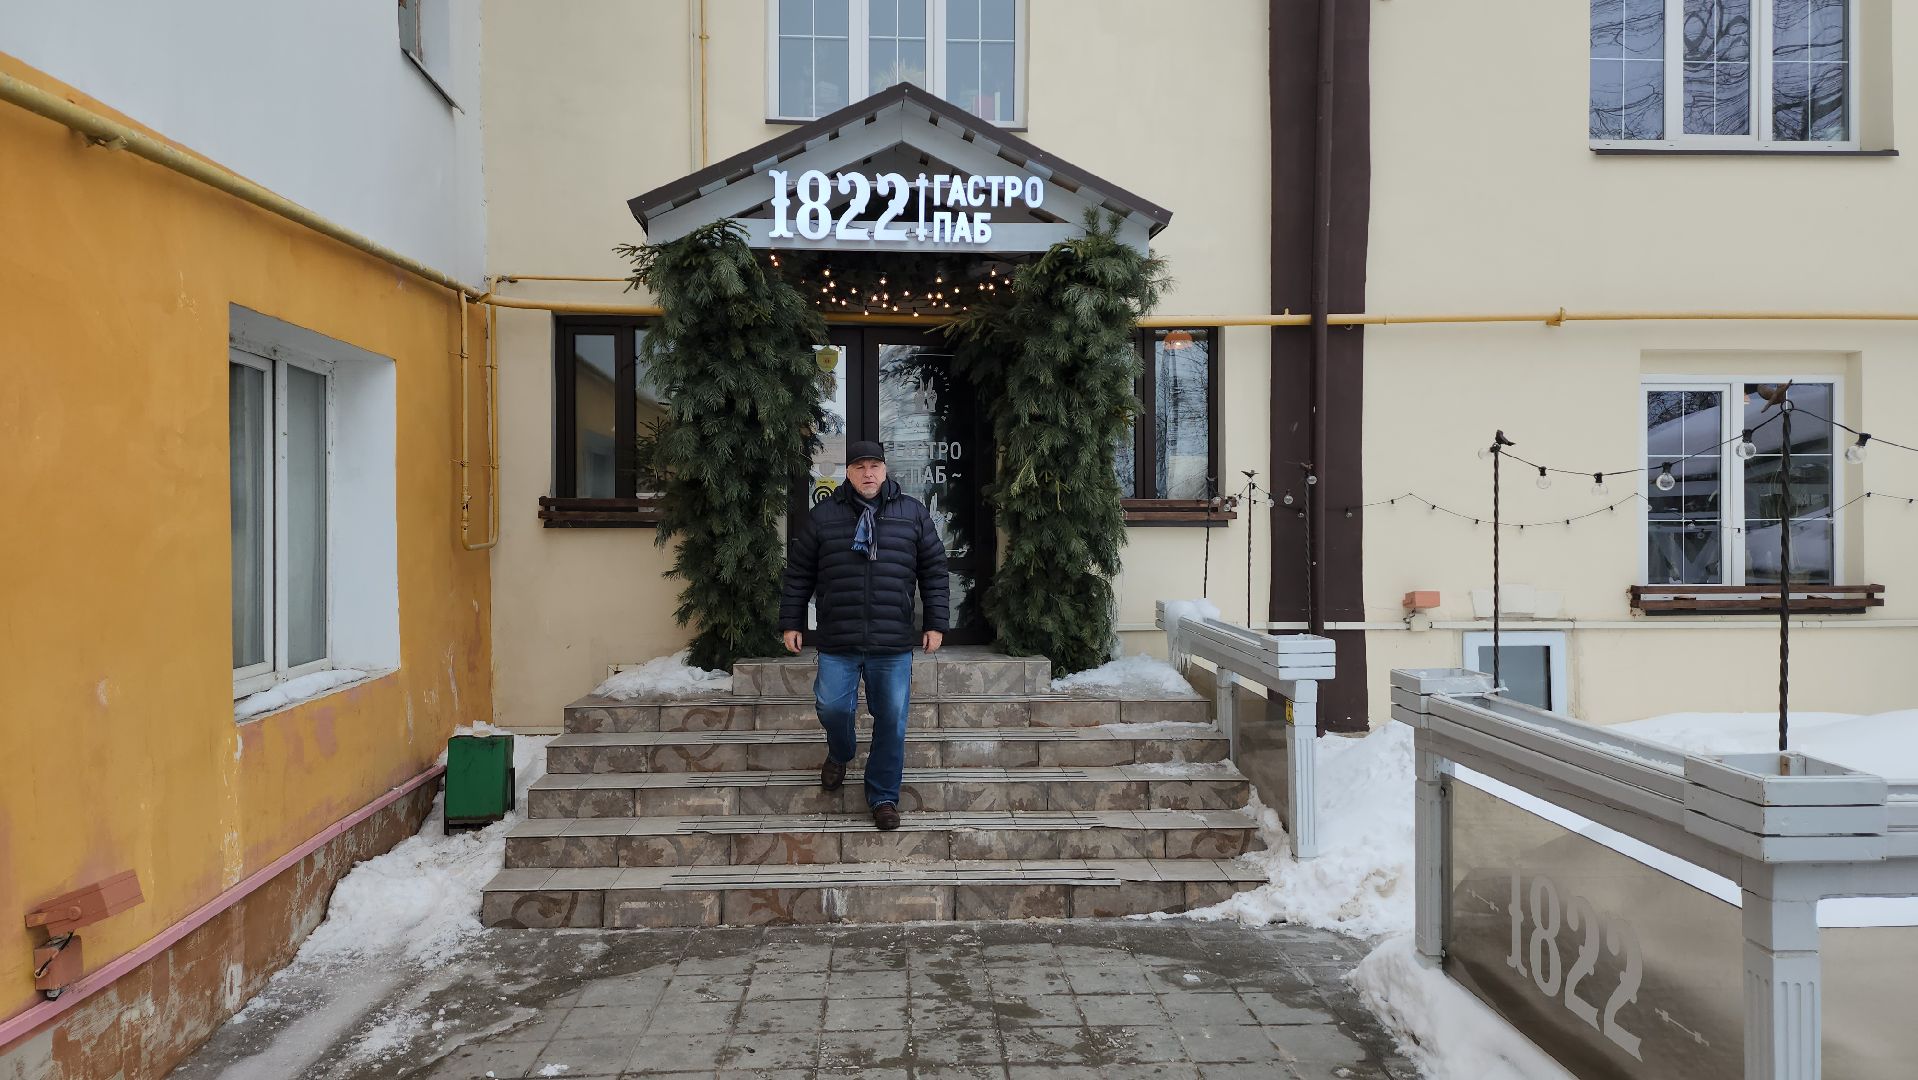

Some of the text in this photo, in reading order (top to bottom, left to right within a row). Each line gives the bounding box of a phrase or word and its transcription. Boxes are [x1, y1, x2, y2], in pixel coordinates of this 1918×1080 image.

[768, 169, 910, 241] 1822
[933, 174, 1044, 208] ГАСТРО
[933, 211, 992, 243] ПАБ
[1506, 862, 1643, 1062] 1822
